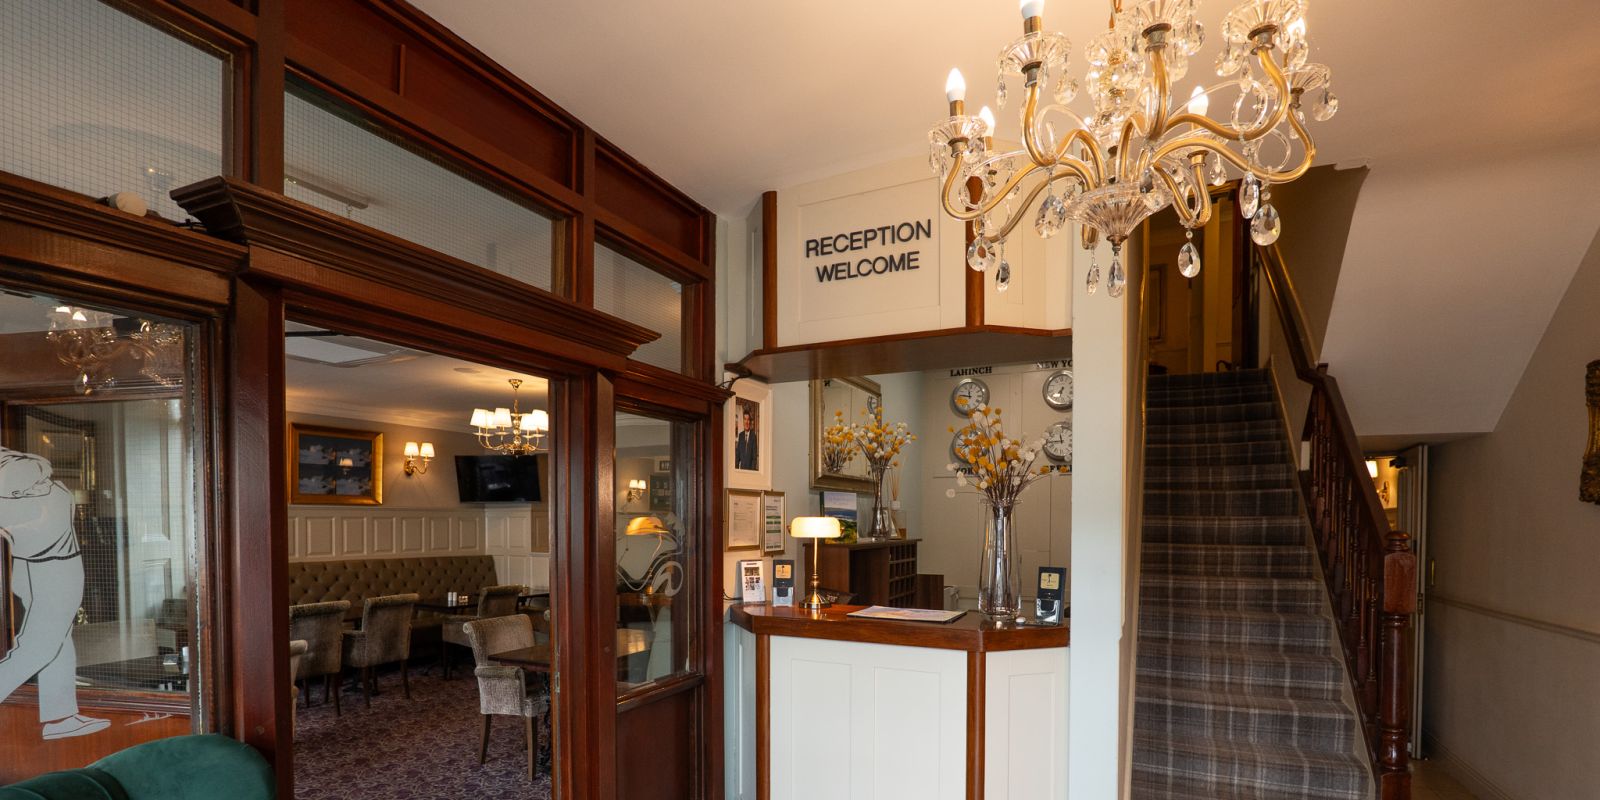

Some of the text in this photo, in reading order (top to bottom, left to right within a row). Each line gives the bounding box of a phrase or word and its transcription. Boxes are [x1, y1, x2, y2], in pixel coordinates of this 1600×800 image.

[805, 219, 932, 258] RECEPTION
[816, 251, 920, 282] WELCOME
[950, 366, 992, 377] LAHINCH
